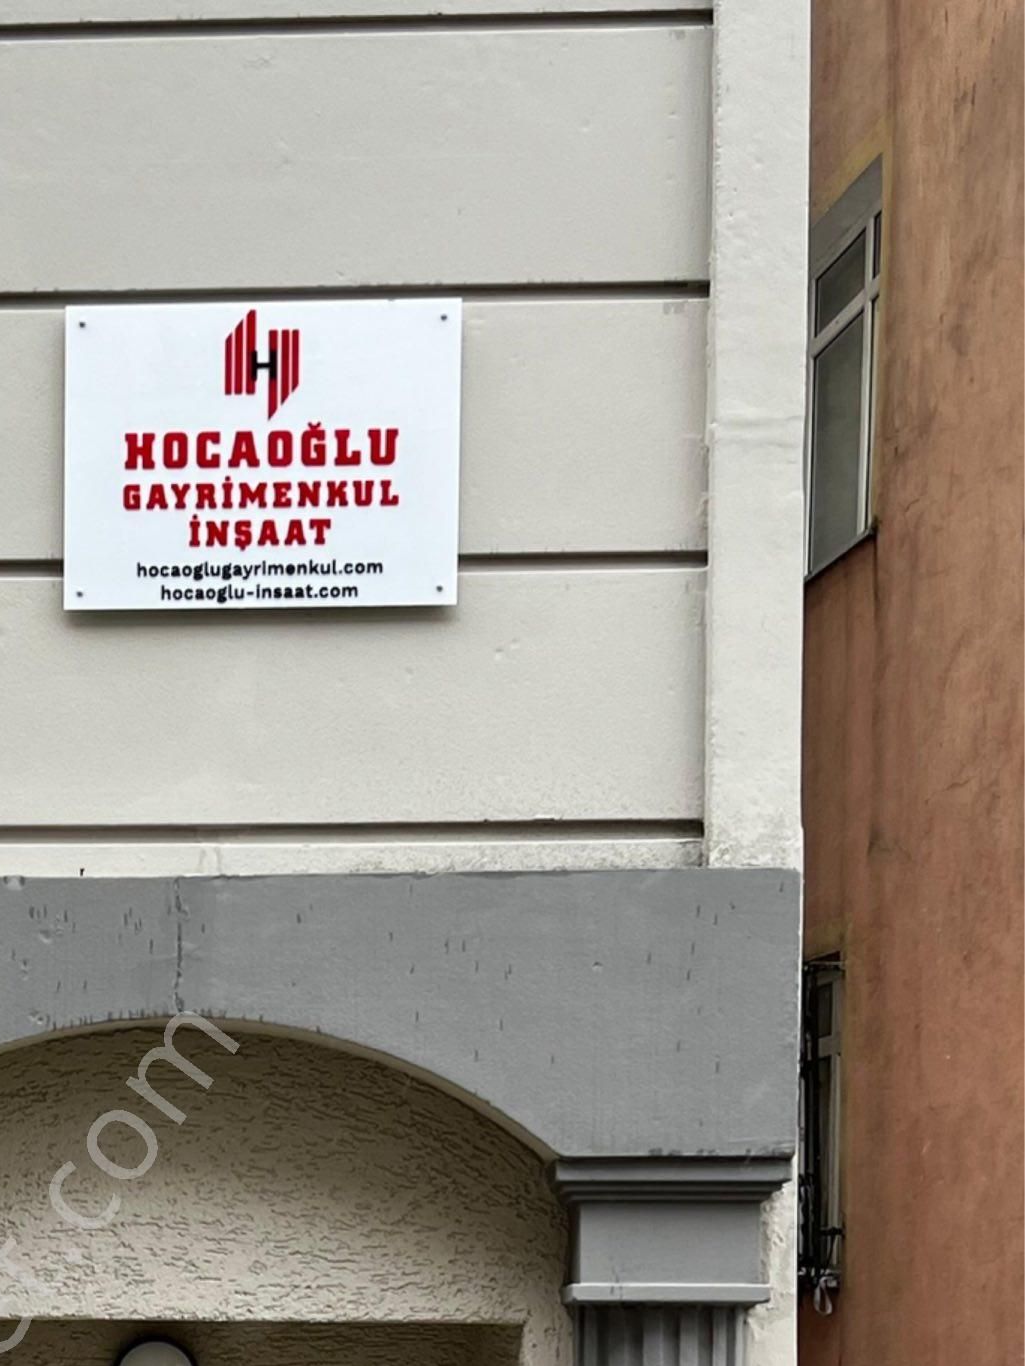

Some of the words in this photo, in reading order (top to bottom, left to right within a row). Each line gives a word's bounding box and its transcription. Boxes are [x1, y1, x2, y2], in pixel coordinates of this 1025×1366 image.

[125, 423, 399, 470] HOCAOĞLU
[123, 477, 399, 511] GAYRİMENKUL
[189, 516, 331, 550] İNŞAAT
[136, 560, 383, 581] hocaoglugayrimenkul.com
[160, 584, 359, 604] hocaoglu-insaat.com
